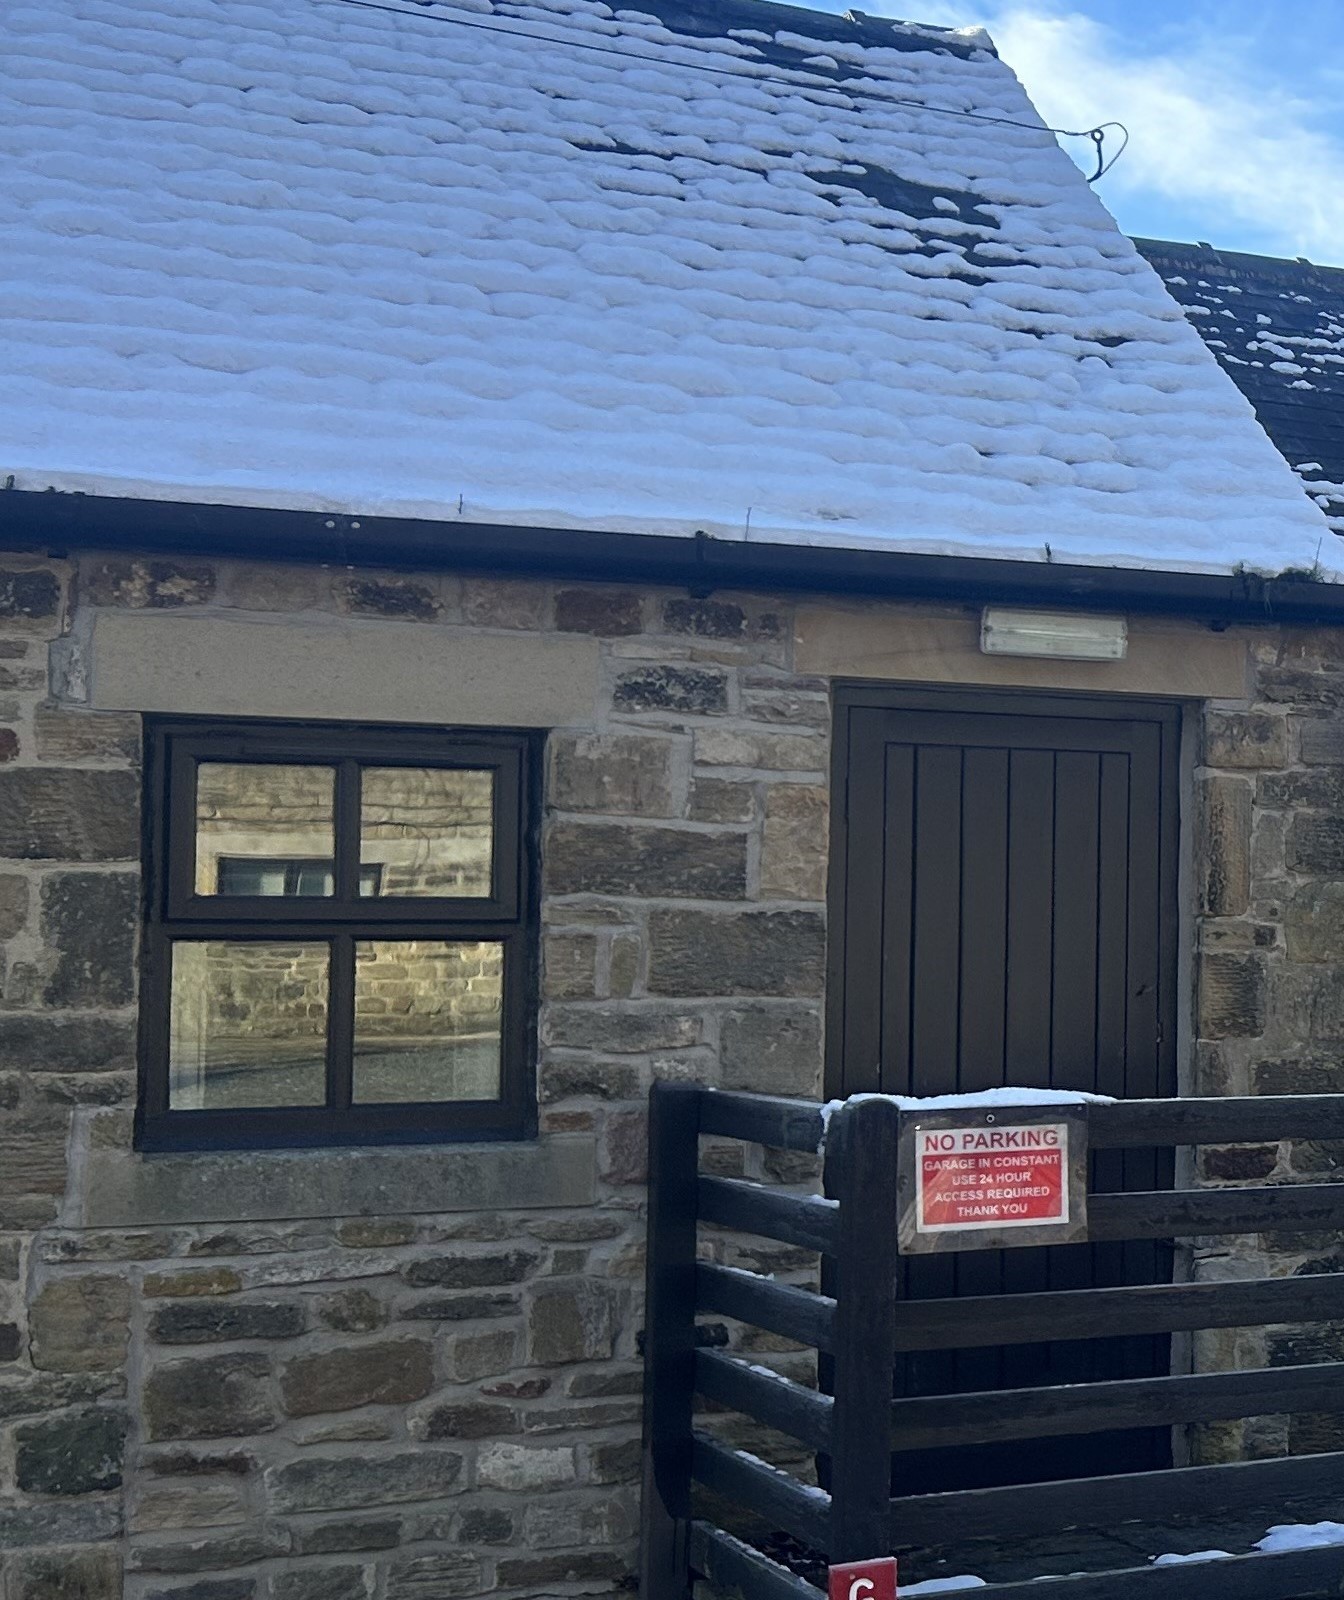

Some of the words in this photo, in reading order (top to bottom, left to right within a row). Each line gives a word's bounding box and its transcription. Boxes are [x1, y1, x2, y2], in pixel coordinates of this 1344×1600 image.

[925, 1134, 956, 1151] NO
[962, 1129, 1058, 1150] PARKING
[924, 1158, 976, 1171] GARAGE
[978, 1158, 990, 1168] IN
[994, 1154, 1059, 1166] CONSTANT
[952, 1176, 976, 1186] USE
[979, 1174, 994, 1184] 24
[996, 1171, 1032, 1183] HOUR
[935, 1190, 984, 1202] ACCESS
[986, 1186, 1050, 1199] REQUIRED
[957, 1205, 1000, 1217] THANK
[1002, 1203, 1028, 1214] YOU
